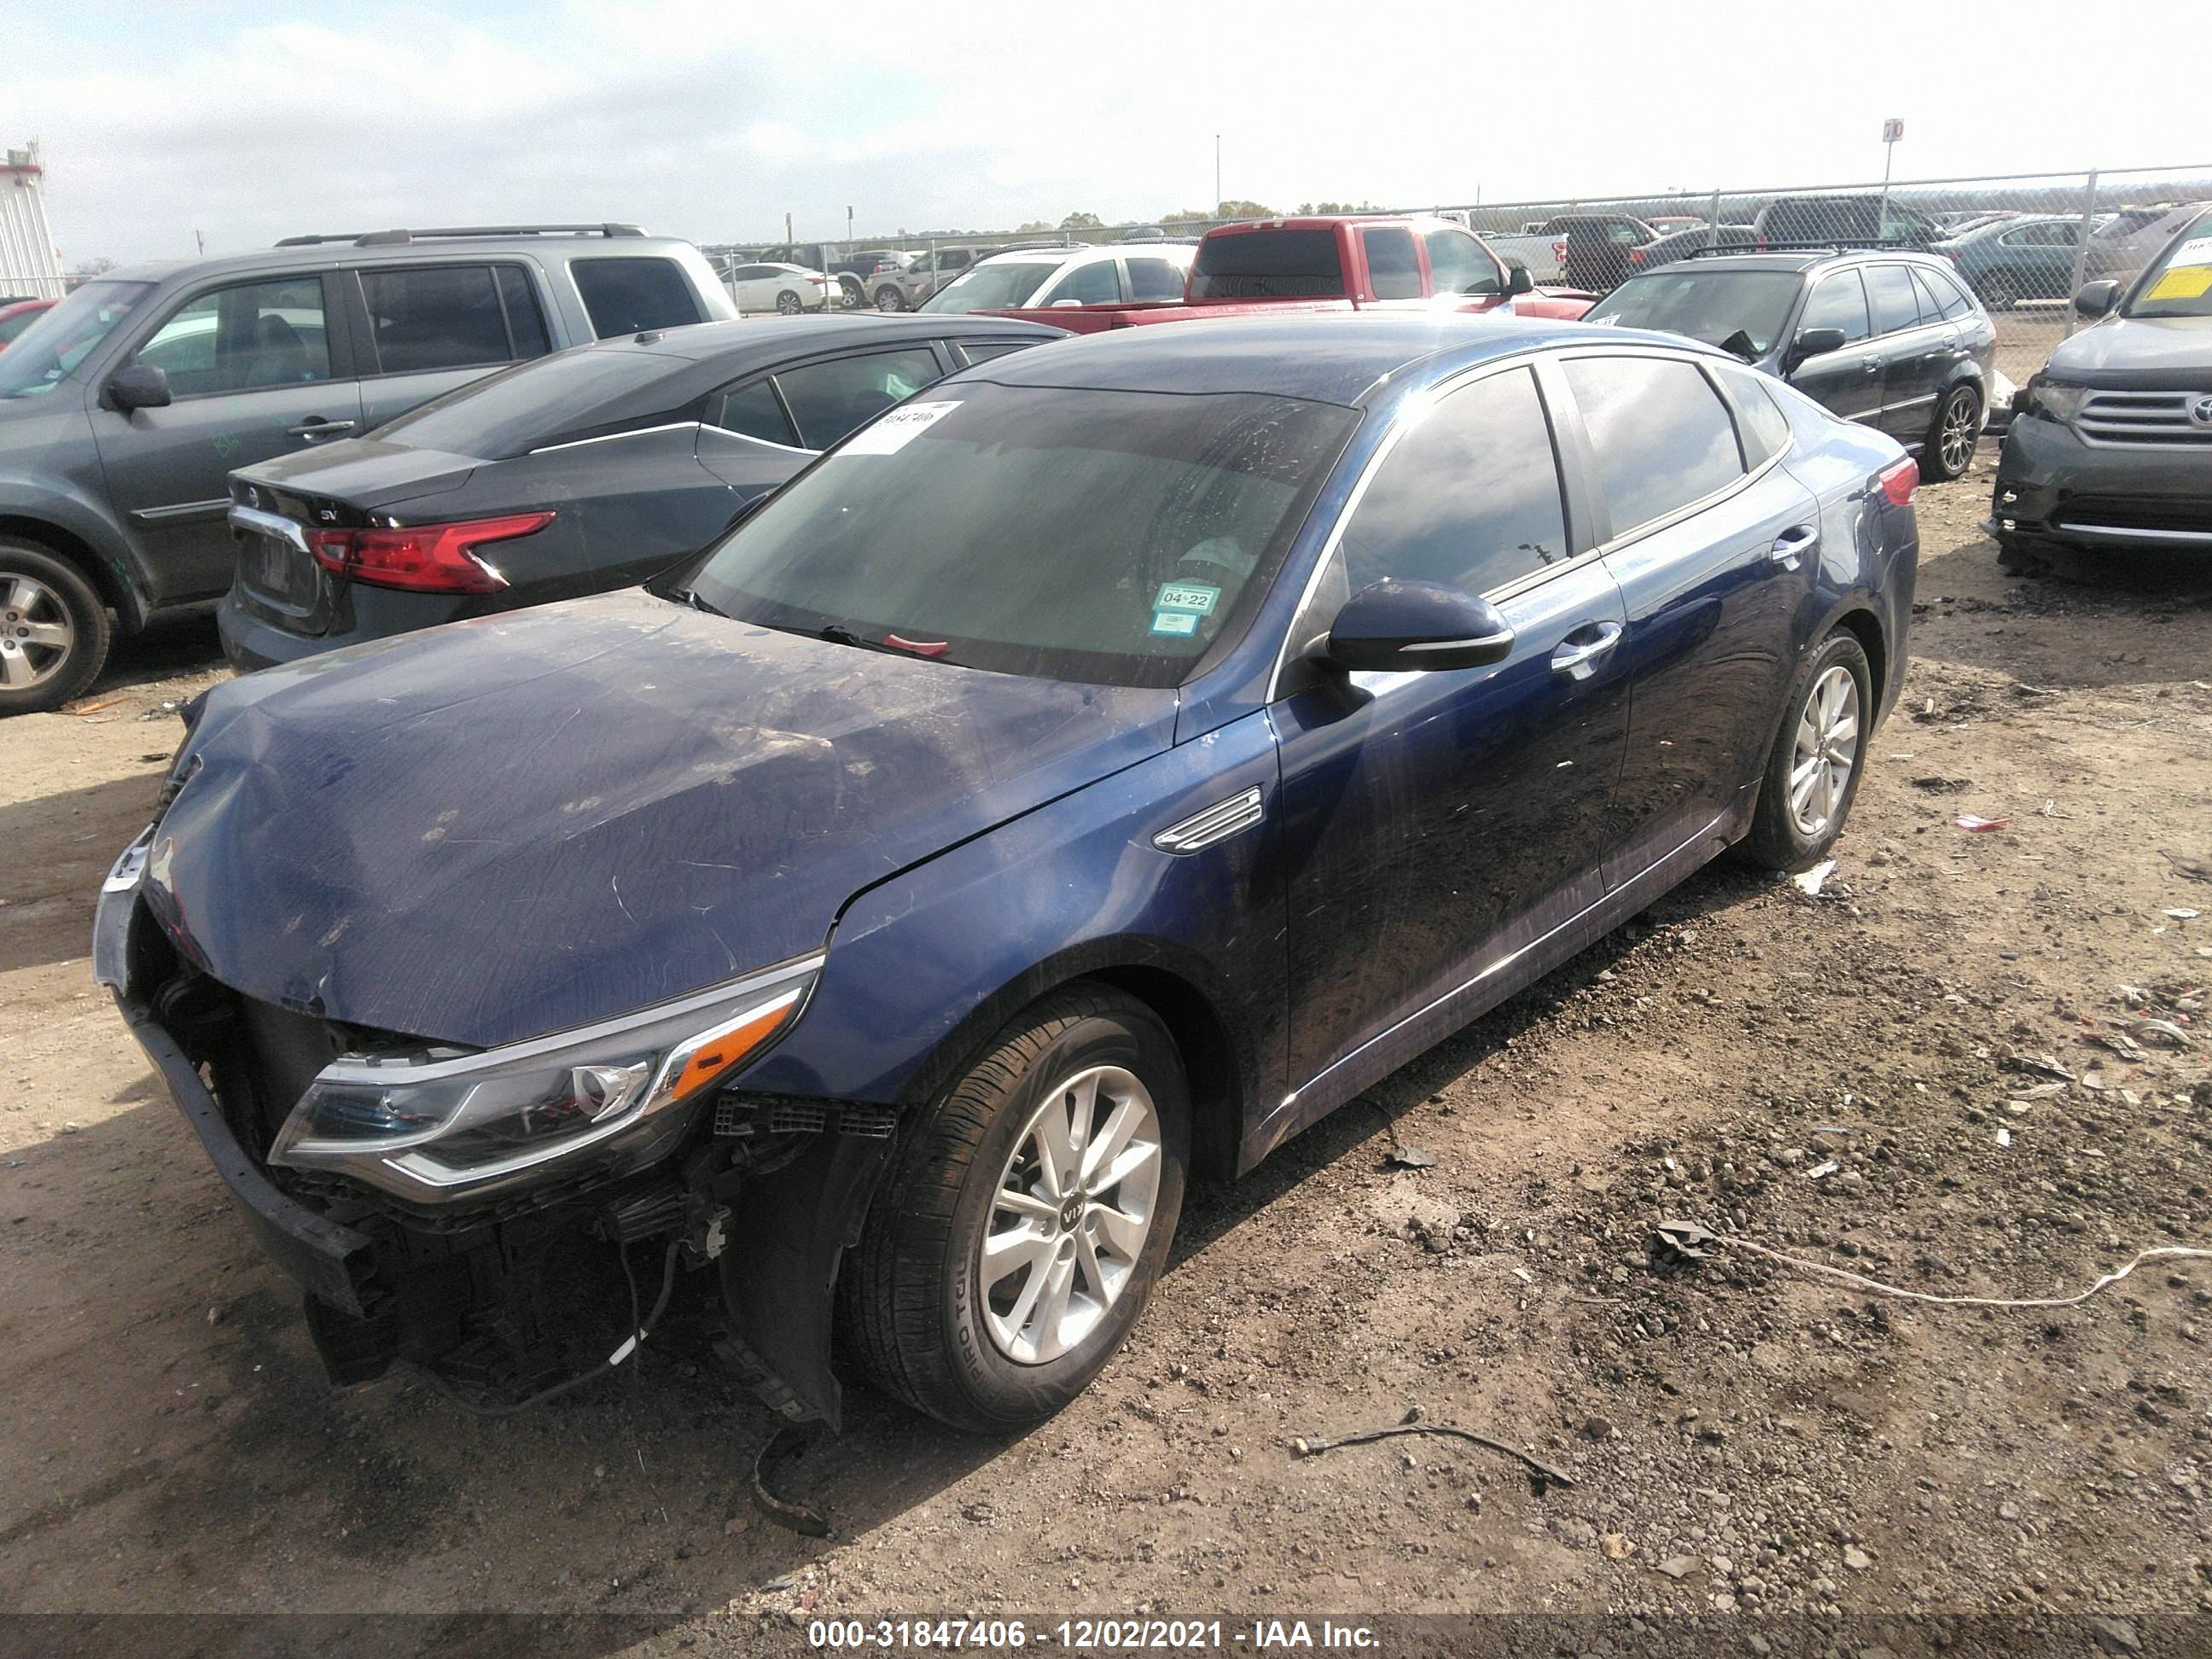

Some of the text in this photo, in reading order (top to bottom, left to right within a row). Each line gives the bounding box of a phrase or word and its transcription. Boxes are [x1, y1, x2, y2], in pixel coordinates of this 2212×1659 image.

[1884, 122, 1904, 137] 70
[320, 509, 338, 520] SV
[1063, 1202, 1084, 1223] KIA
